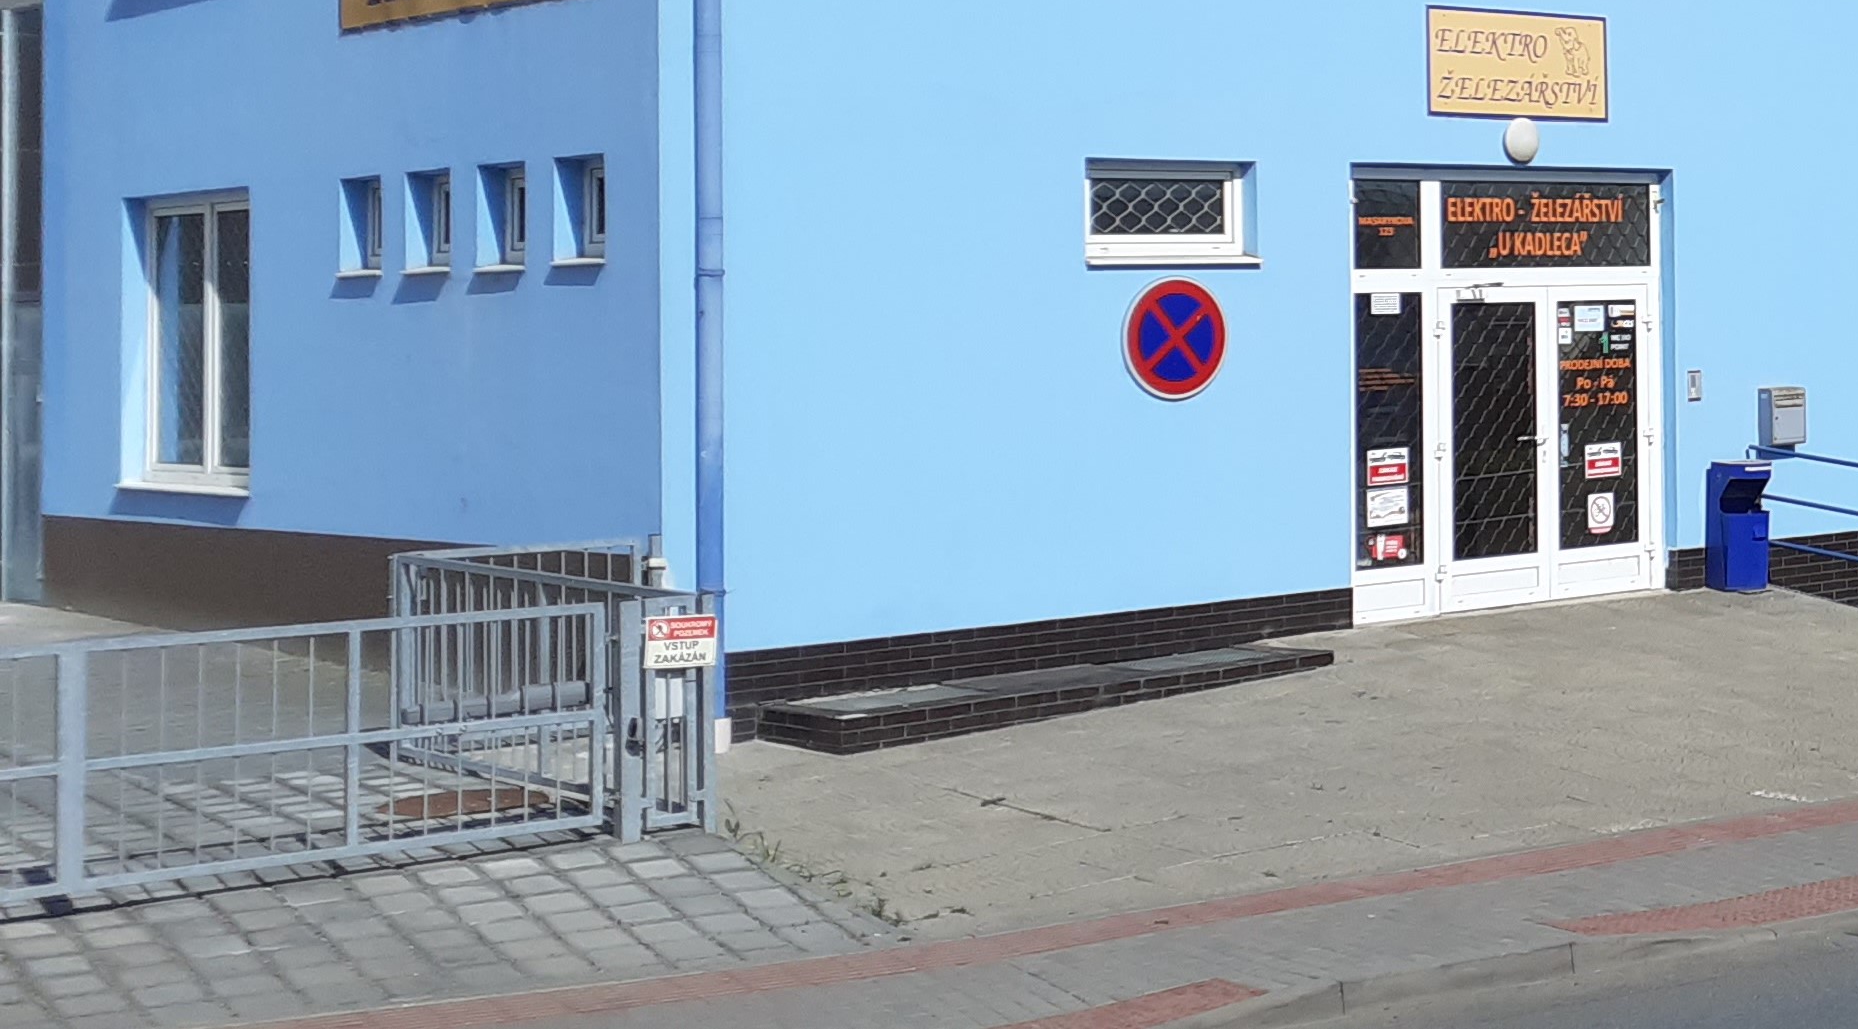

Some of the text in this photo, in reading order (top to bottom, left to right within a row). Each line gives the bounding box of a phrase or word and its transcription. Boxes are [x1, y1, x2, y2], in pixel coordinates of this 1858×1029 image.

[1435, 28, 1548, 63] ELEKTRO
[1437, 69, 1599, 109] ŽELEZÁŘSTVÍ
[1447, 197, 1515, 222] ELEKTRO
[1531, 191, 1624, 222] ŽELEZÁŘSTVÍ
[653, 651, 707, 664] ZAKÁZÁN
[664, 640, 700, 651] VSTUP
